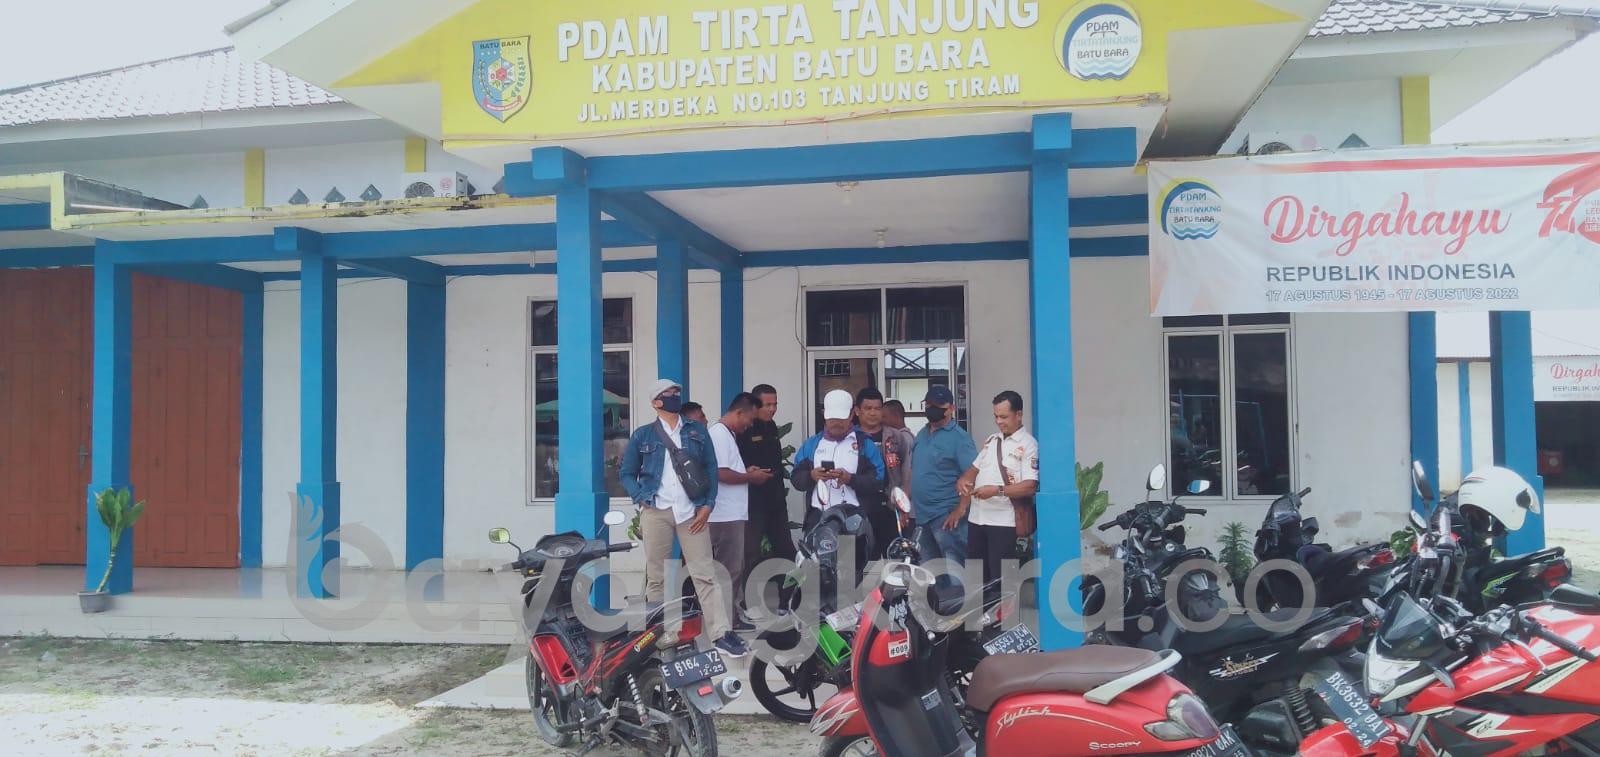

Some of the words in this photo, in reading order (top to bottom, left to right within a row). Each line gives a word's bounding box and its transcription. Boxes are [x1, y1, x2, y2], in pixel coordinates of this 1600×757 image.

[558, 15, 669, 62] PDAM
[692, 4, 814, 52] TIRTA
[832, 0, 1039, 40] TANJUNG
[1086, 20, 1119, 32] PDAM
[1077, 50, 1102, 59] BATU
[1103, 48, 1129, 57] BARA
[592, 53, 777, 94] KABUPATEN
[793, 45, 878, 82] BATU
[894, 37, 990, 73] BARA
[577, 95, 718, 122] JL.MERDEKA
[733, 88, 806, 113] NO.103
[819, 80, 929, 106] TANJUNG
[944, 73, 1020, 99] TIRAM
[1180, 192, 1207, 201] PDAM
[1173, 216, 1193, 224] BATU
[1194, 215, 1215, 223] BARA
[1263, 191, 1512, 257] Dirgahayu
[1266, 265, 1381, 282] REPUBLIK
[1387, 263, 1516, 280] INDONESIA
[1266, 289, 1282, 302] 17
[1284, 289, 1351, 301] AGUSTUS
[1354, 288, 1386, 301] 1945
[1398, 288, 1413, 300] 17
[1415, 287, 1484, 300] AGUSTUS
[1486, 287, 1520, 300] 2022
[661, 665, 671, 677] E
[705, 651, 721, 663] YZ
